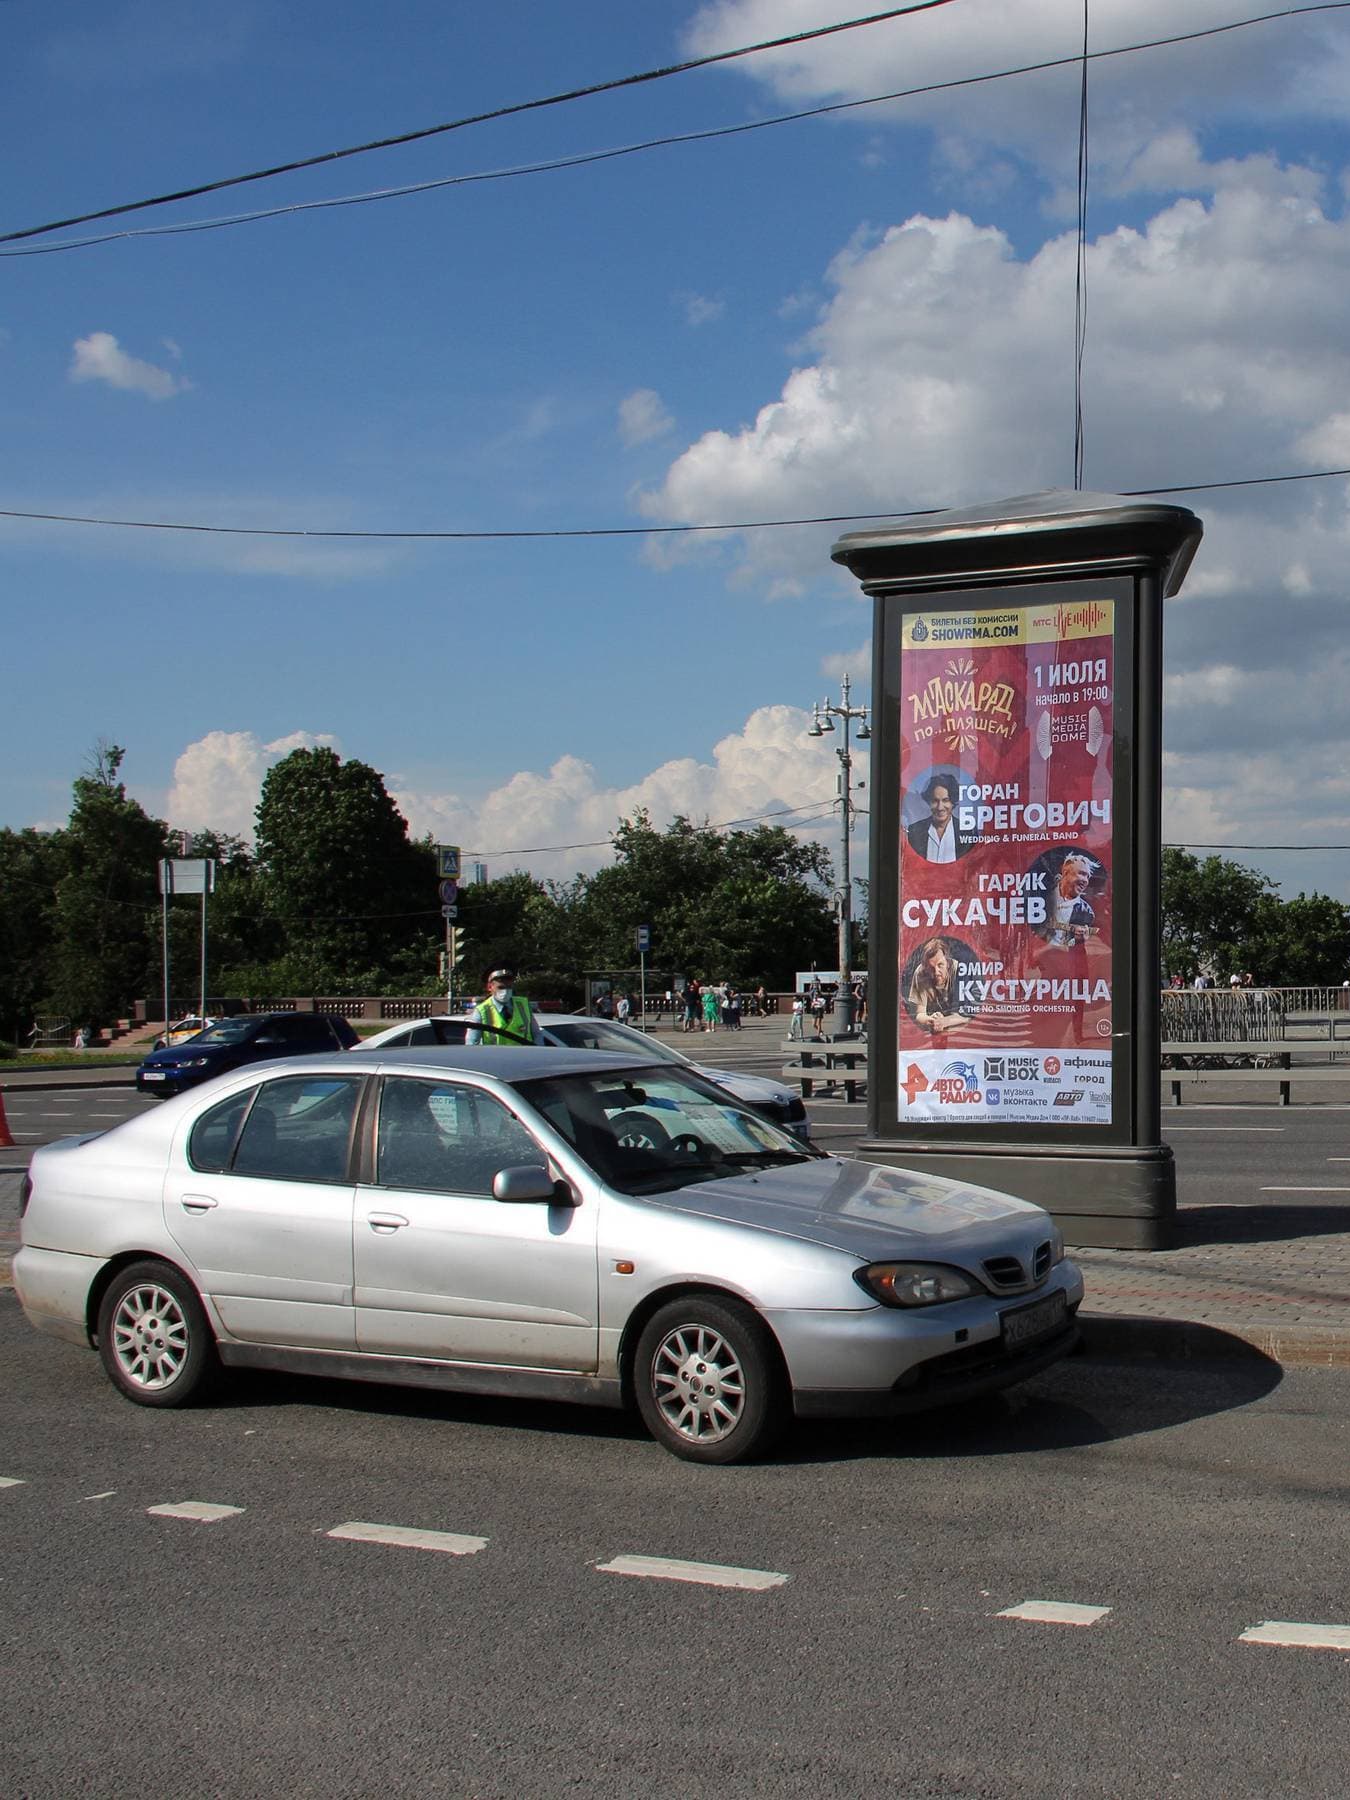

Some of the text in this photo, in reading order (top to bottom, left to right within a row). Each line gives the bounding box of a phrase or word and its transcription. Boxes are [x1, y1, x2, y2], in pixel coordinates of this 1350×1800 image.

[931, 618, 961, 626] БИЛЕТЫ
[978, 615, 1018, 624] КОМИССИИ
[932, 625, 1018, 641] SHOWRMA.COM
[1034, 659, 1107, 688] 1 ИЮЛЯ
[1036, 692, 1070, 706] начало
[1082, 686, 1108, 702] 19:00
[1052, 714, 1087, 724] MUSIC
[1052, 724, 1087, 733] MEDIA
[1052, 734, 1087, 743] DOME
[959, 783, 1019, 801] ГОРАН
[959, 800, 1110, 831] БРЕГОВИЧ
[960, 835, 1000, 844] WEDDING
[1012, 833, 1050, 842] FUNERAL
[1053, 832, 1078, 840] BAND
[979, 873, 1046, 892] ГАРИК
[902, 890, 1047, 928] СУКАЧЁВ
[958, 961, 1003, 976] ЭМИР
[958, 979, 1111, 1003] КУСТУРИЦА
[996, 1005, 1030, 1013] SMOKING
[1033, 1005, 1076, 1013] ORCHESTRA
[1008, 1058, 1039, 1066] MUSIC
[1064, 1056, 1112, 1068] афиша
[1008, 1068, 1039, 1080] BOX
[1075, 1075, 1105, 1084] ГОРОД
[931, 1079, 963, 1092] АВТО
[940, 1090, 982, 1104] РАДИО
[1004, 1089, 1034, 1097] музыка
